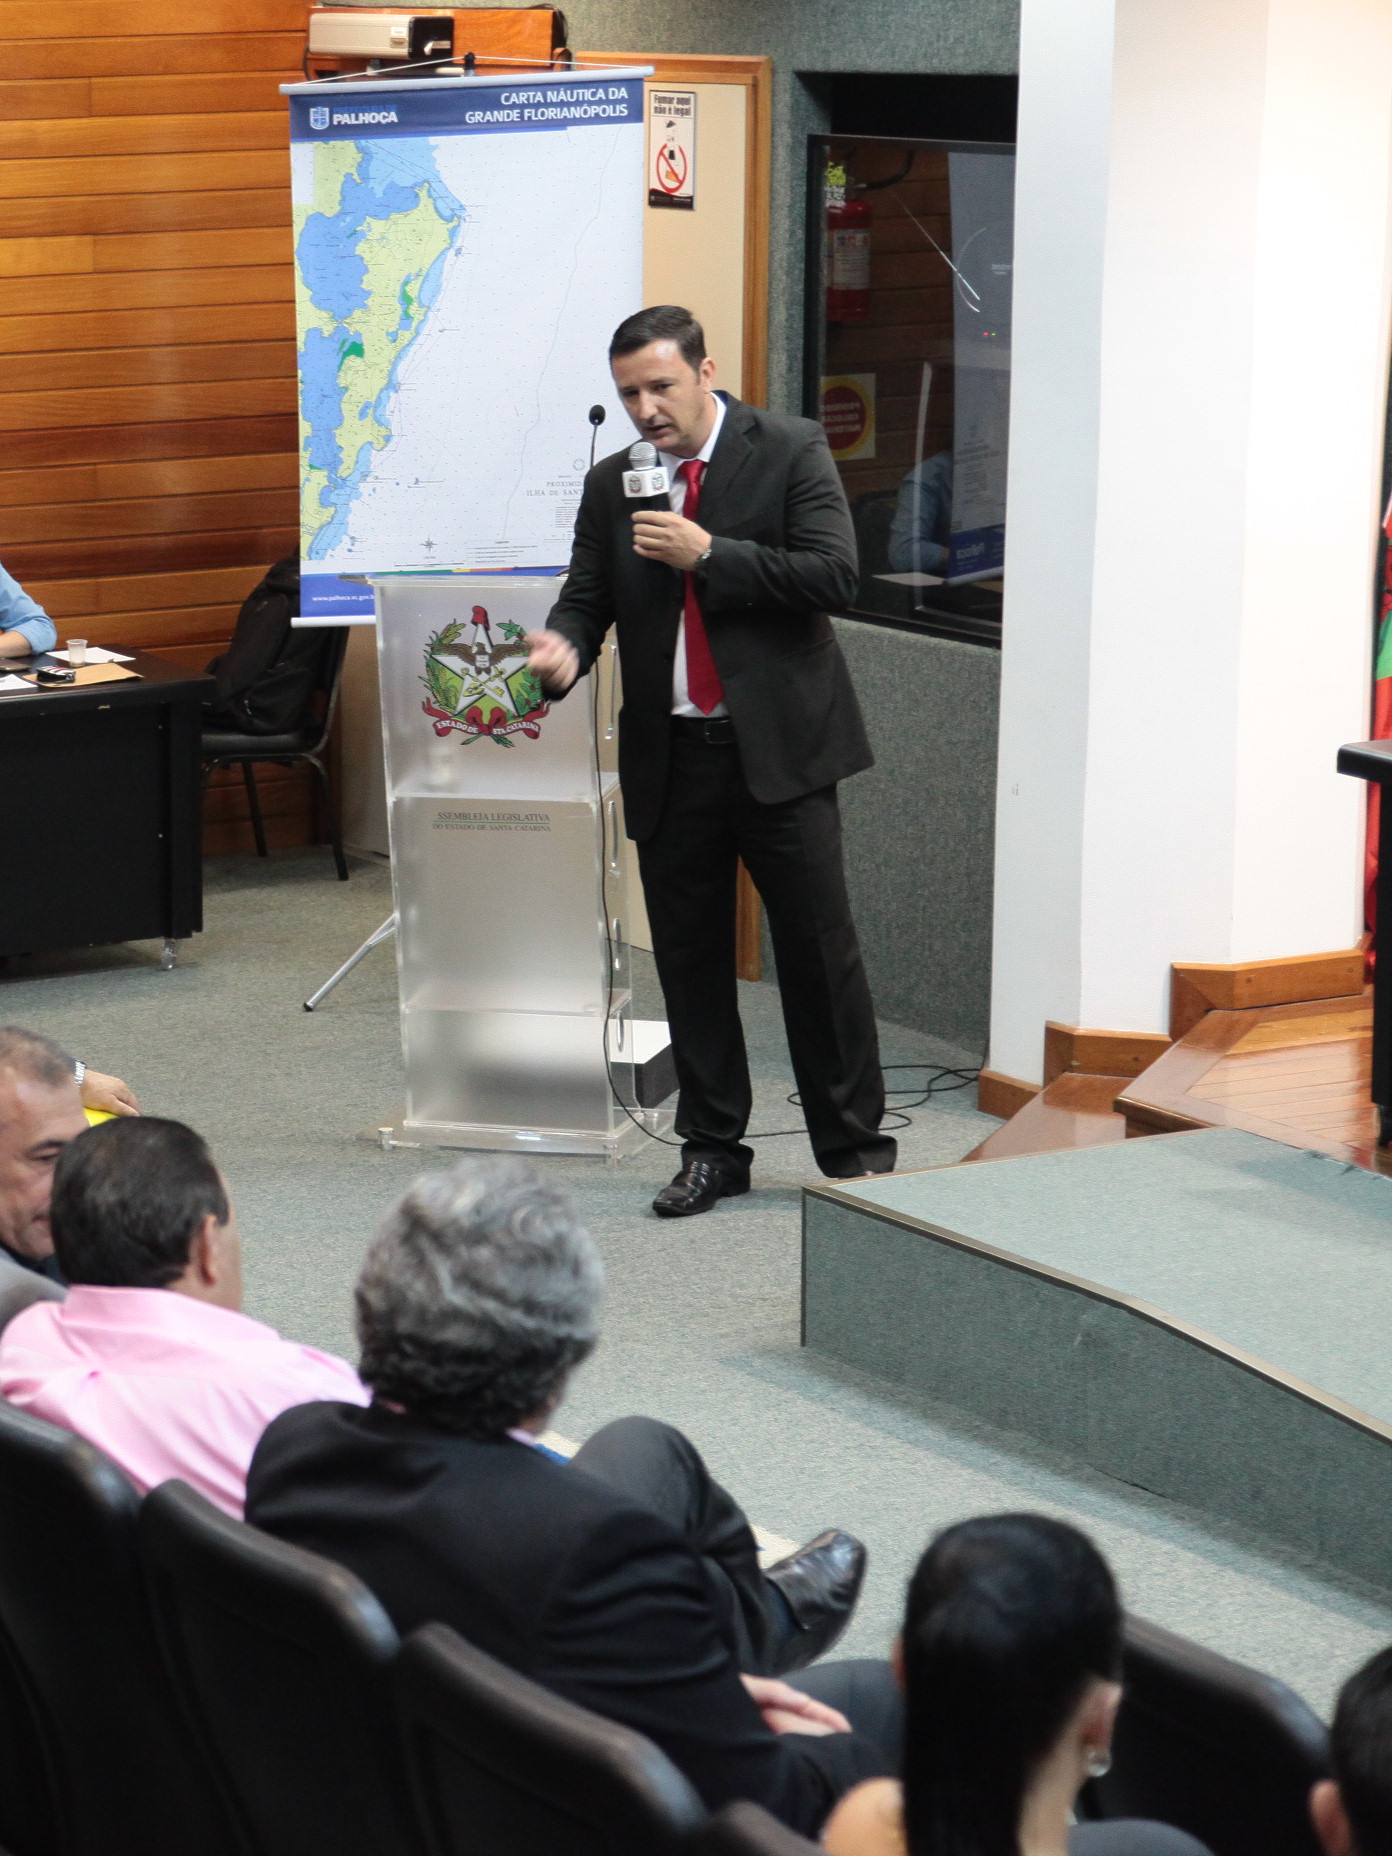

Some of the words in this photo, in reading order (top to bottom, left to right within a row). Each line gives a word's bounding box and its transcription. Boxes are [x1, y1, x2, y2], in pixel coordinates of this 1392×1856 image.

[500, 91, 544, 105] CARTA
[546, 87, 606, 103] NÁUTICA
[608, 87, 628, 99] DA
[333, 111, 398, 125] PALHOÇA
[465, 109, 521, 123] GRANDE
[523, 104, 628, 121] FLORIANÓPOLIS
[436, 720, 467, 731] ESTADO
[467, 726, 479, 734] DE
[491, 813, 550, 821] LEGISLATIVA
